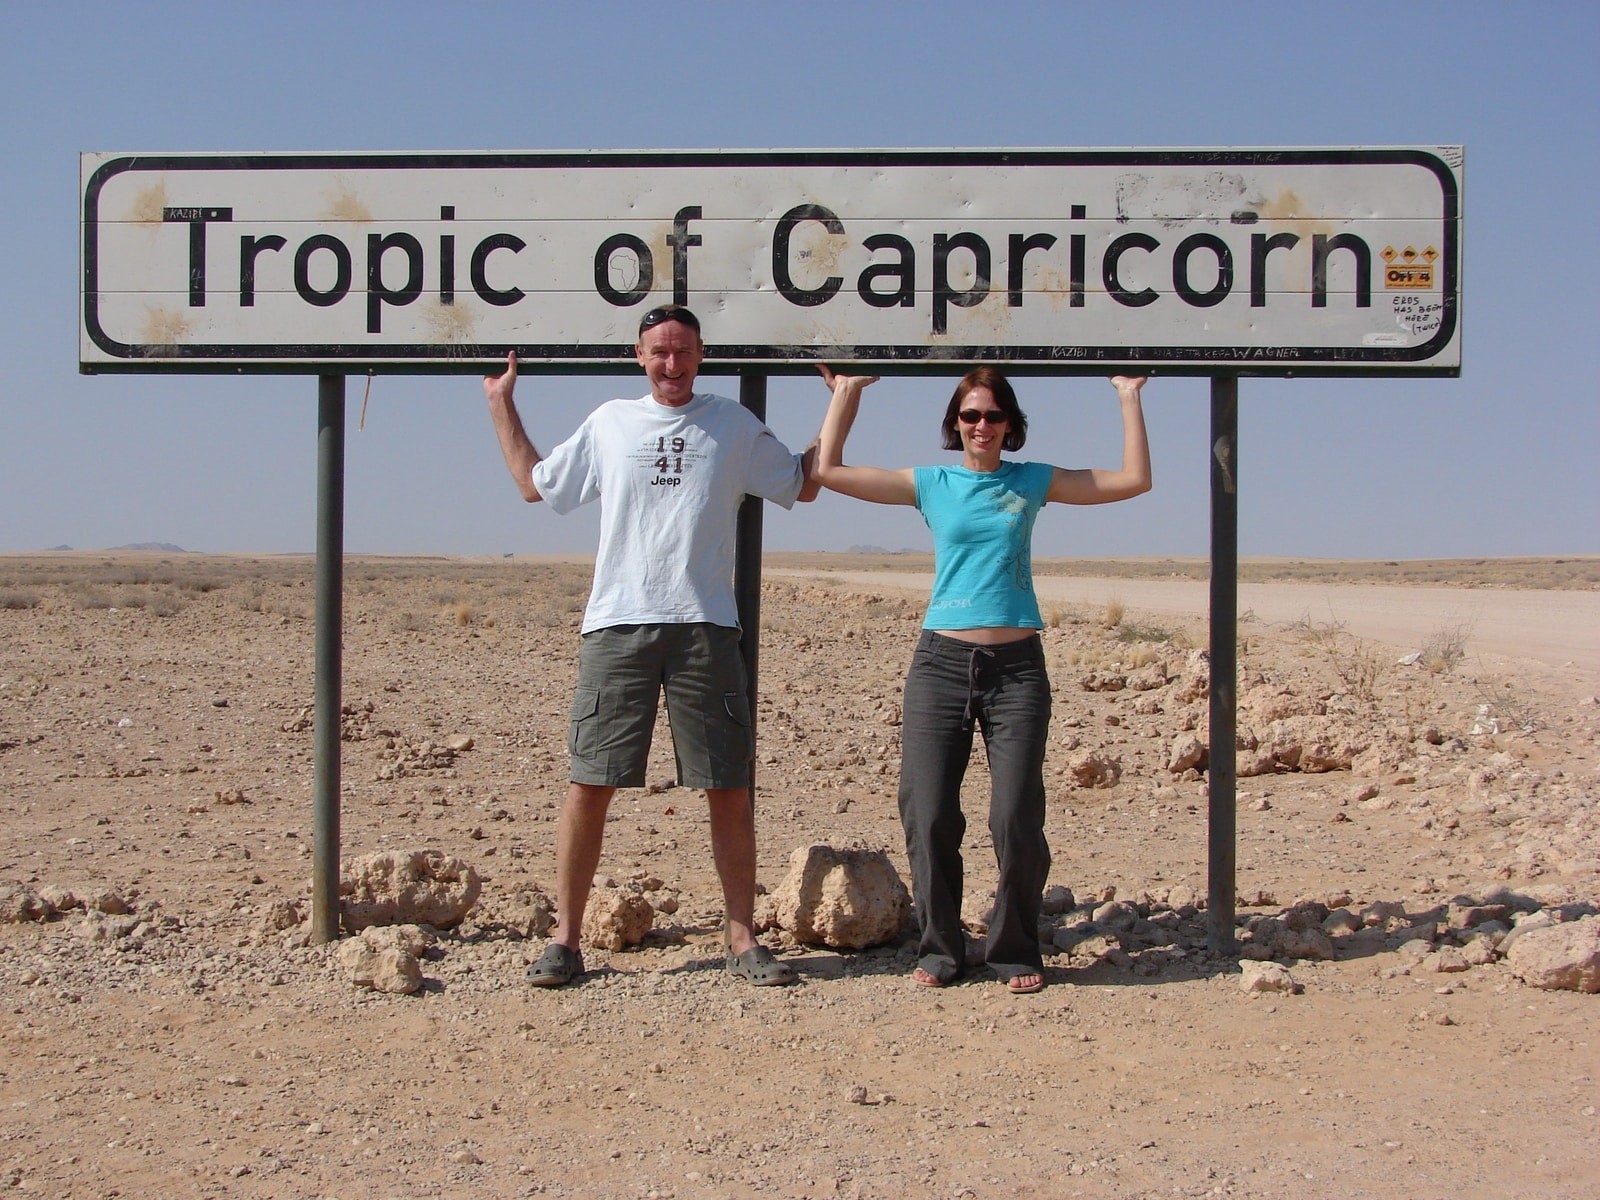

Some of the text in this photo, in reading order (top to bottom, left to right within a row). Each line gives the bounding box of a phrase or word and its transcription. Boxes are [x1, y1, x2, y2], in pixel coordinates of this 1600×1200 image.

[162, 203, 1371, 336] Tropic of Capricorn
[1392, 295, 1420, 305] EROS
[1393, 306, 1413, 314] HAS
[657, 436, 684, 453] 19
[654, 456, 683, 473] 41
[651, 476, 681, 487] Jeep
